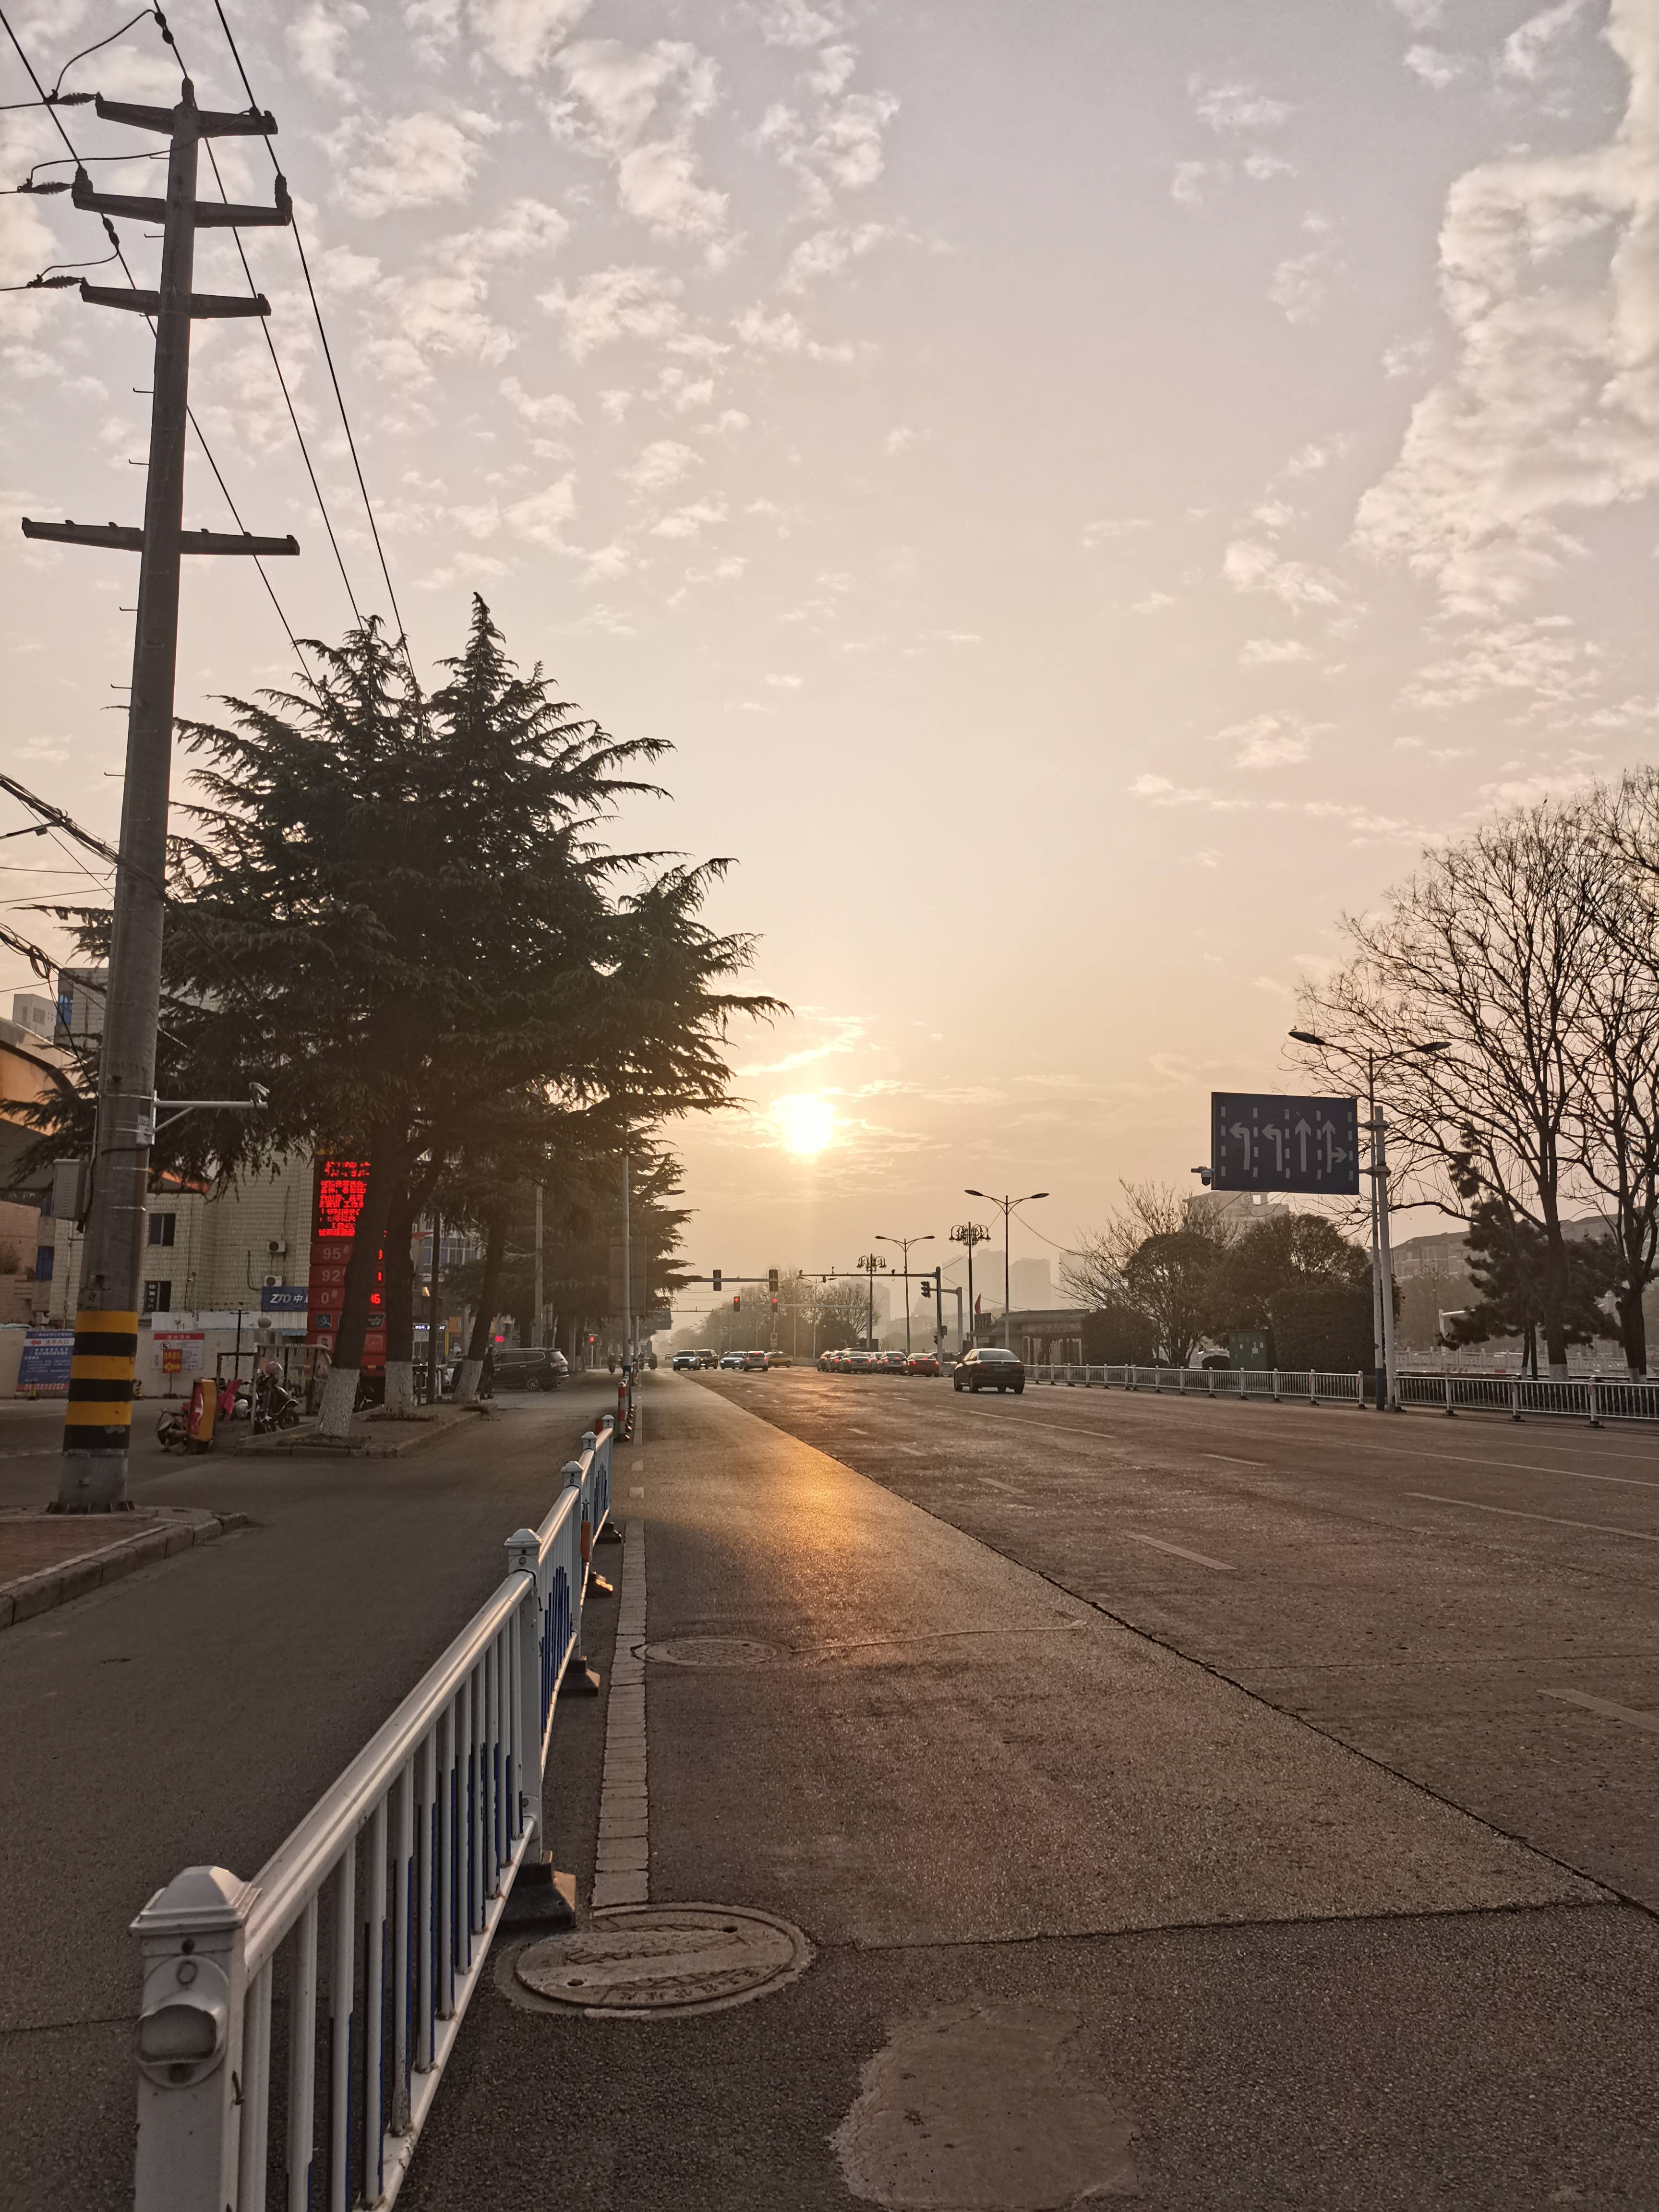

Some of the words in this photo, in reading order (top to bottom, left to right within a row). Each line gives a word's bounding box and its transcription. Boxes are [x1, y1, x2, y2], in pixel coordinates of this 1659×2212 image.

[323, 1246, 349, 1260] 95#
[322, 1267, 346, 1282] 92
[269, 1294, 291, 1304] ZTO
[321, 1290, 338, 1304] 0#
